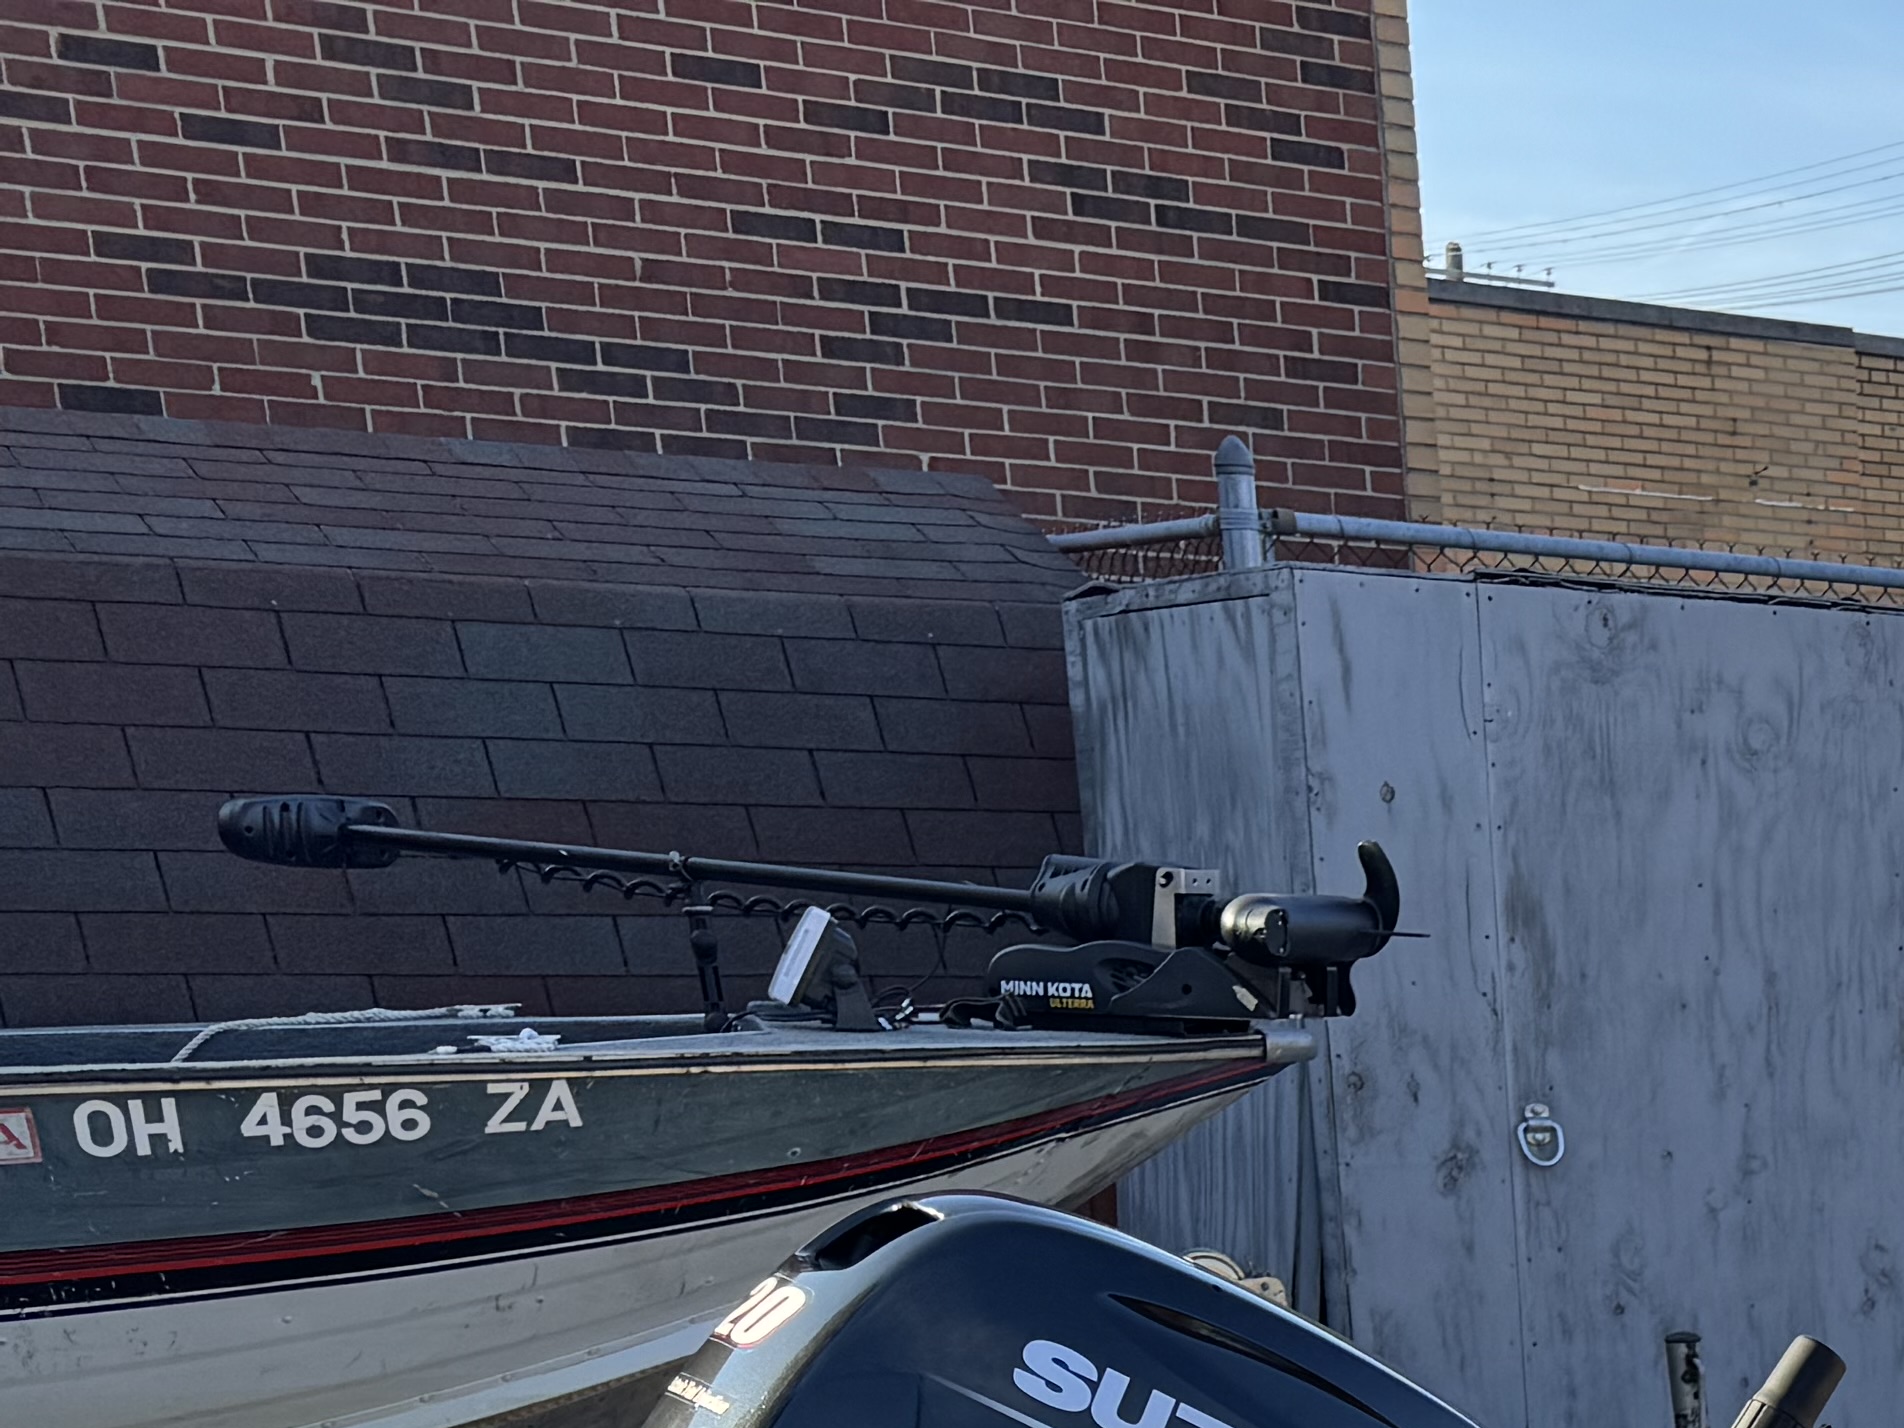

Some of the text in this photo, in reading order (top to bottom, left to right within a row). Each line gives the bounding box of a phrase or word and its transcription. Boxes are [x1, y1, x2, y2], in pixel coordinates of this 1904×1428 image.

[1000, 980, 1093, 998] MINN KOTA
[73, 1097, 183, 1158] OH
[240, 1089, 431, 1149] 4656
[484, 1079, 583, 1135] ZA
[714, 1276, 806, 1346] 20
